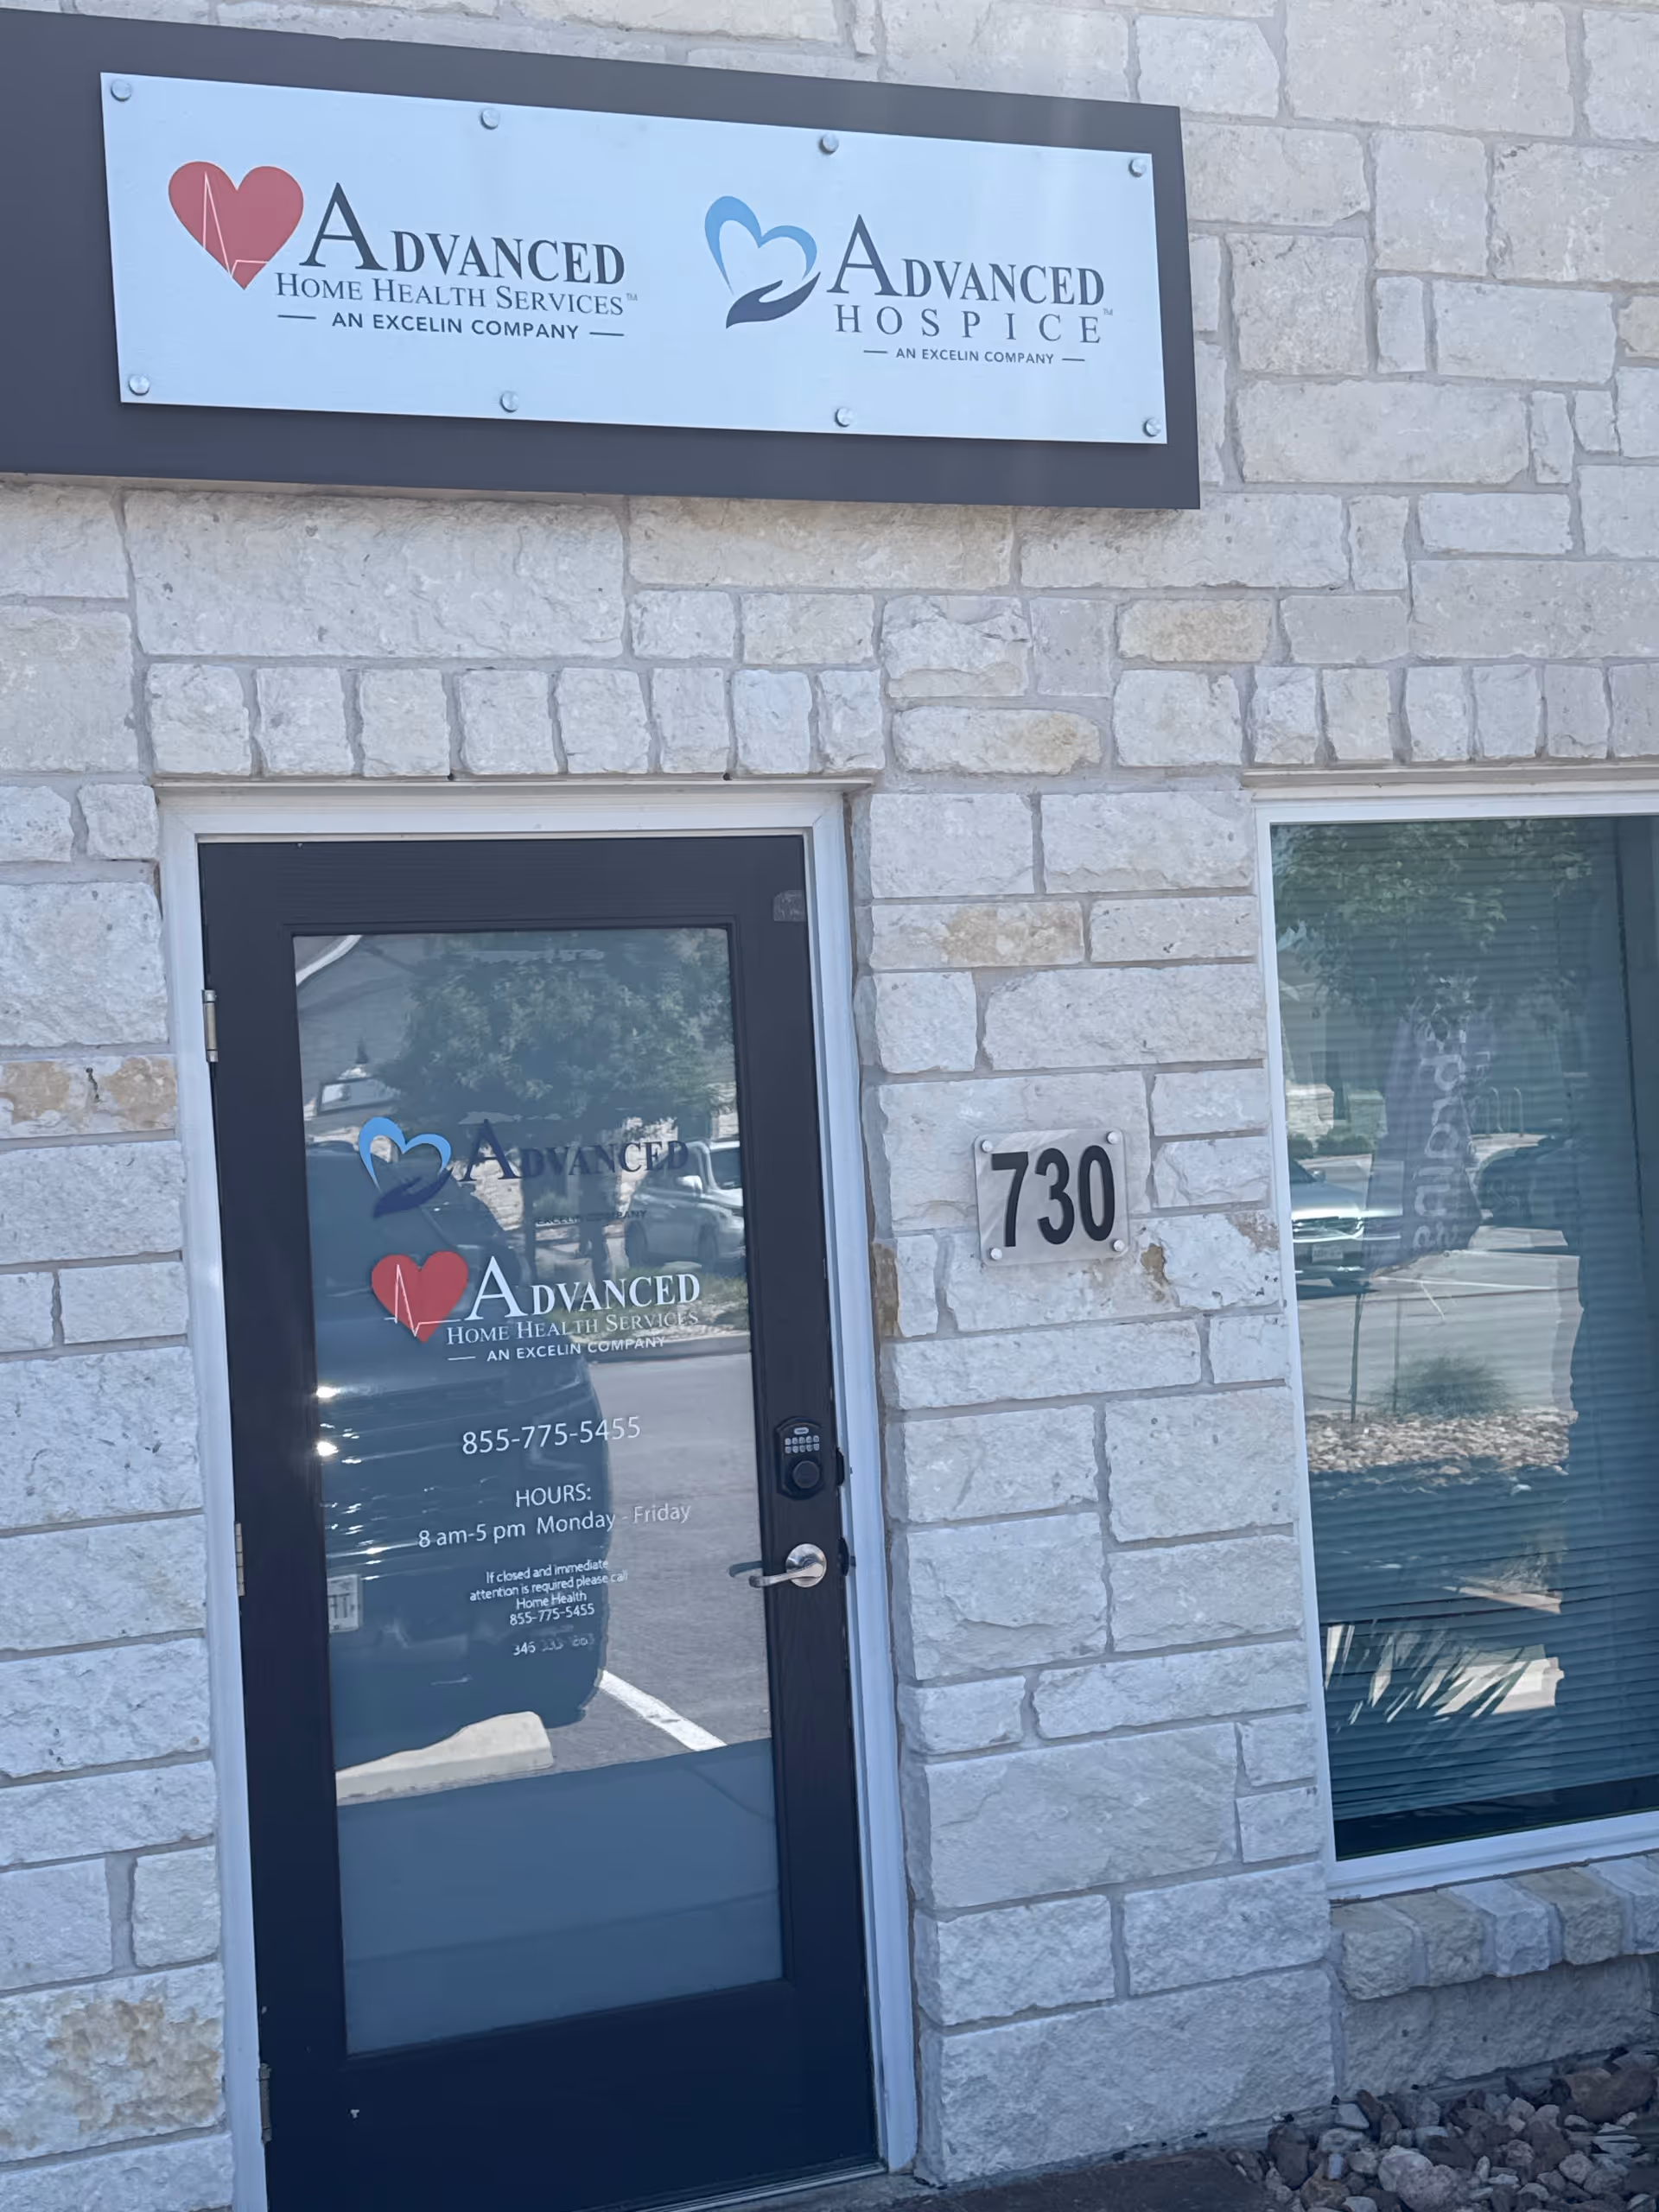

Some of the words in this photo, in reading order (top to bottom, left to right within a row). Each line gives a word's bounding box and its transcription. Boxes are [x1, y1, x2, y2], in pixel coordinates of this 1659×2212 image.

[299, 182, 625, 285] ADVANCED
[826, 213, 1104, 306] ADVANCED
[274, 272, 364, 301] HOME
[372, 277, 486, 308] HEALTH
[496, 285, 624, 316] SERVICES
[332, 312, 364, 328] AN
[372, 314, 462, 334] EXCELIN
[471, 319, 579, 340] COMPANY
[834, 303, 1102, 344] HOSPICE
[895, 347, 917, 359] AN
[922, 348, 979, 362] EXCELIN
[984, 351, 1054, 365] COMPANY
[991, 1145, 1116, 1248] 730
[464, 1255, 700, 1321] ADVANCED
[447, 1325, 511, 1345] HOME
[516, 1319, 598, 1339] HEALTH
[486, 1348, 510, 1362] AN
[516, 1343, 582, 1360] EXCELIN
[588, 1336, 665, 1354] COMPANY
[462, 1415, 641, 1455] 855-775-5455
[515, 1483, 592, 1508] HOURS:
[419, 1530, 431, 1548] 8
[436, 1523, 486, 1547] am-5
[493, 1522, 526, 1544] pm
[537, 1510, 615, 1535] Monday
[633, 1503, 691, 1524] Friday
[469, 1586, 519, 1602] attention
[521, 1583, 530, 1595] is
[531, 1578, 575, 1594] required
[575, 1573, 609, 1590] please
[610, 1569, 628, 1583] call
[486, 1571, 495, 1584] If
[497, 1567, 531, 1583] closed
[532, 1564, 552, 1579] and
[554, 1559, 609, 1576] immediate
[509, 1603, 595, 1626] 855-775-5455
[516, 1597, 550, 1611] Home
[550, 1590, 588, 1605] Health
